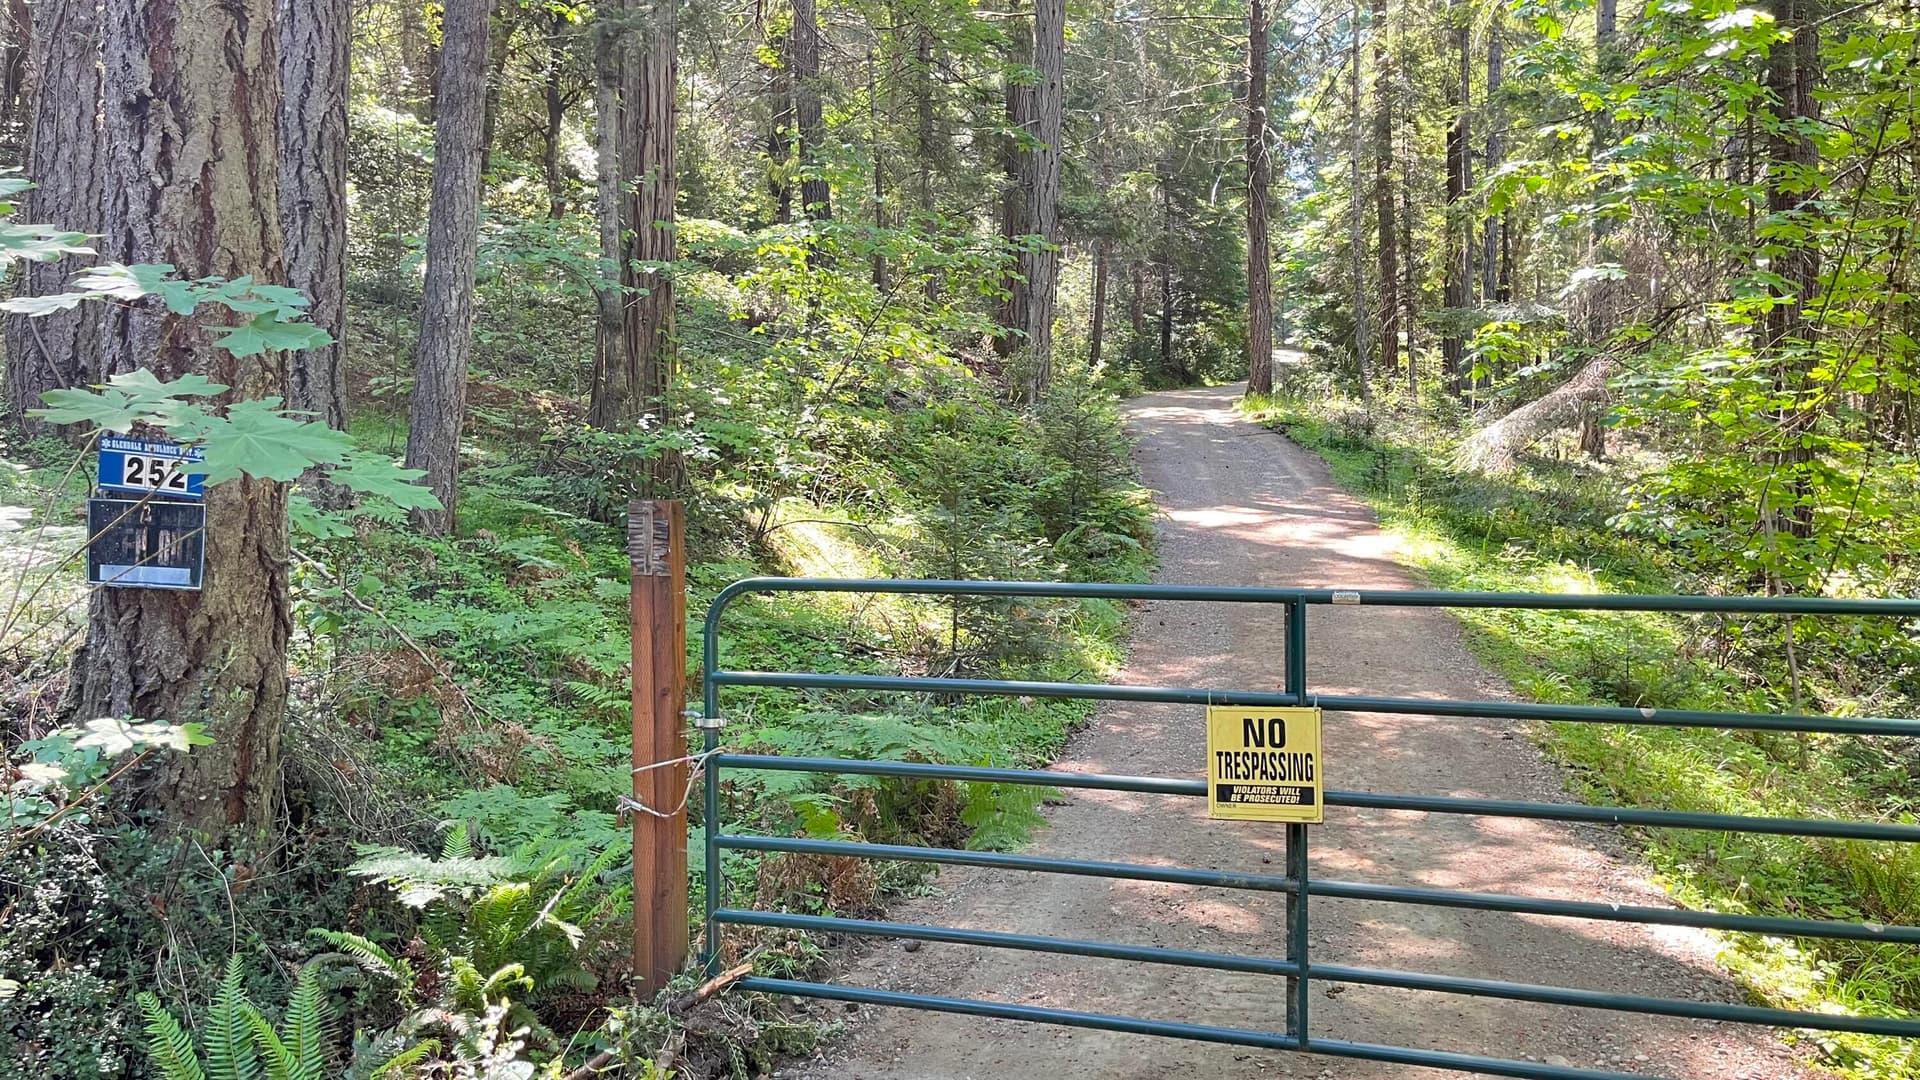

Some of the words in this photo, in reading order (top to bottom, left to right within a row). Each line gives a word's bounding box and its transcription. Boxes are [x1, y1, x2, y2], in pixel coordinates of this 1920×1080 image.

[112, 440, 142, 451] GLENDALE
[126, 457, 185, 489] 252
[1243, 718, 1286, 748] NO
[1216, 751, 1314, 782] TRESPASSING
[1230, 794, 1242, 802] BE
[1243, 795, 1300, 804] PROSECUTED!
[1233, 785, 1277, 795] VIOLATORS
[1279, 787, 1301, 796] WILL
